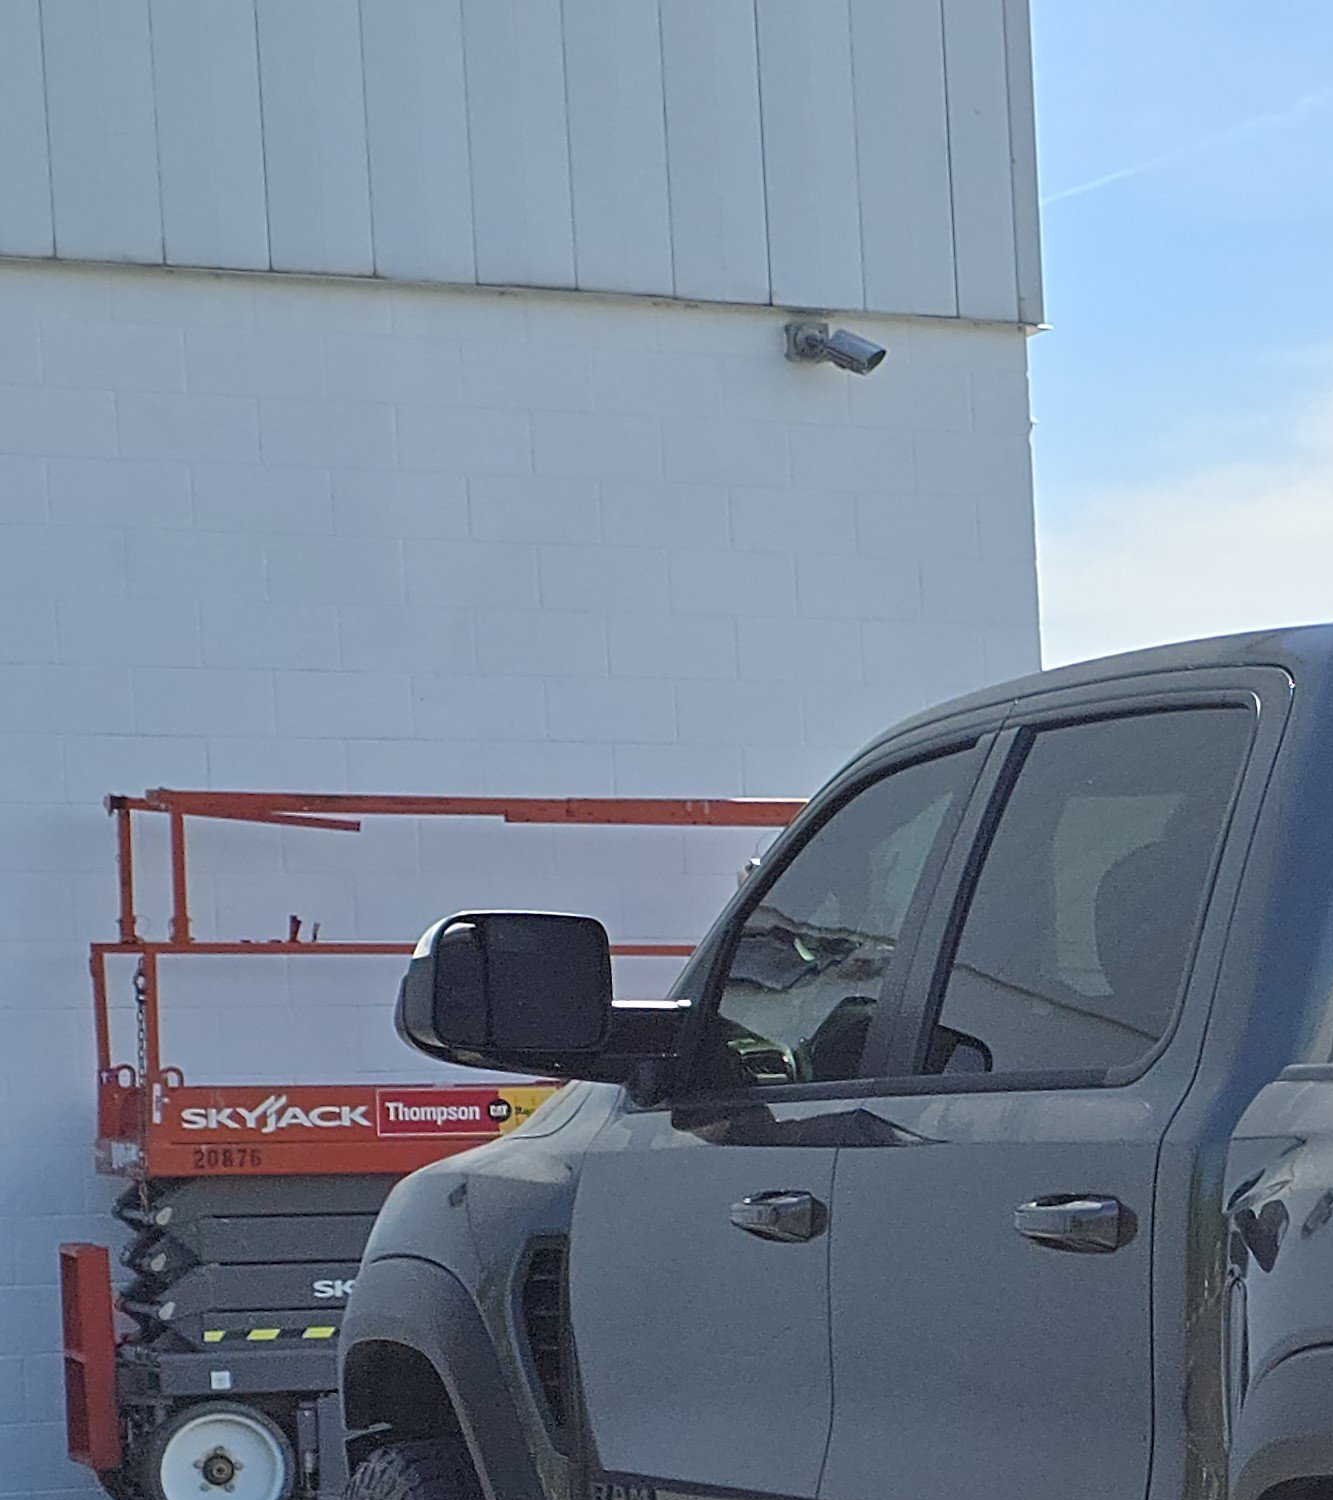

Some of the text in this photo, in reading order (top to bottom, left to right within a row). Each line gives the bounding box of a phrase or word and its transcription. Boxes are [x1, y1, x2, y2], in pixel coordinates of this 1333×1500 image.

[180, 1094, 373, 1134] SKYJACK
[384, 1101, 481, 1127] Thompson
[489, 1104, 508, 1117] CAT
[192, 1149, 262, 1170] 20876
